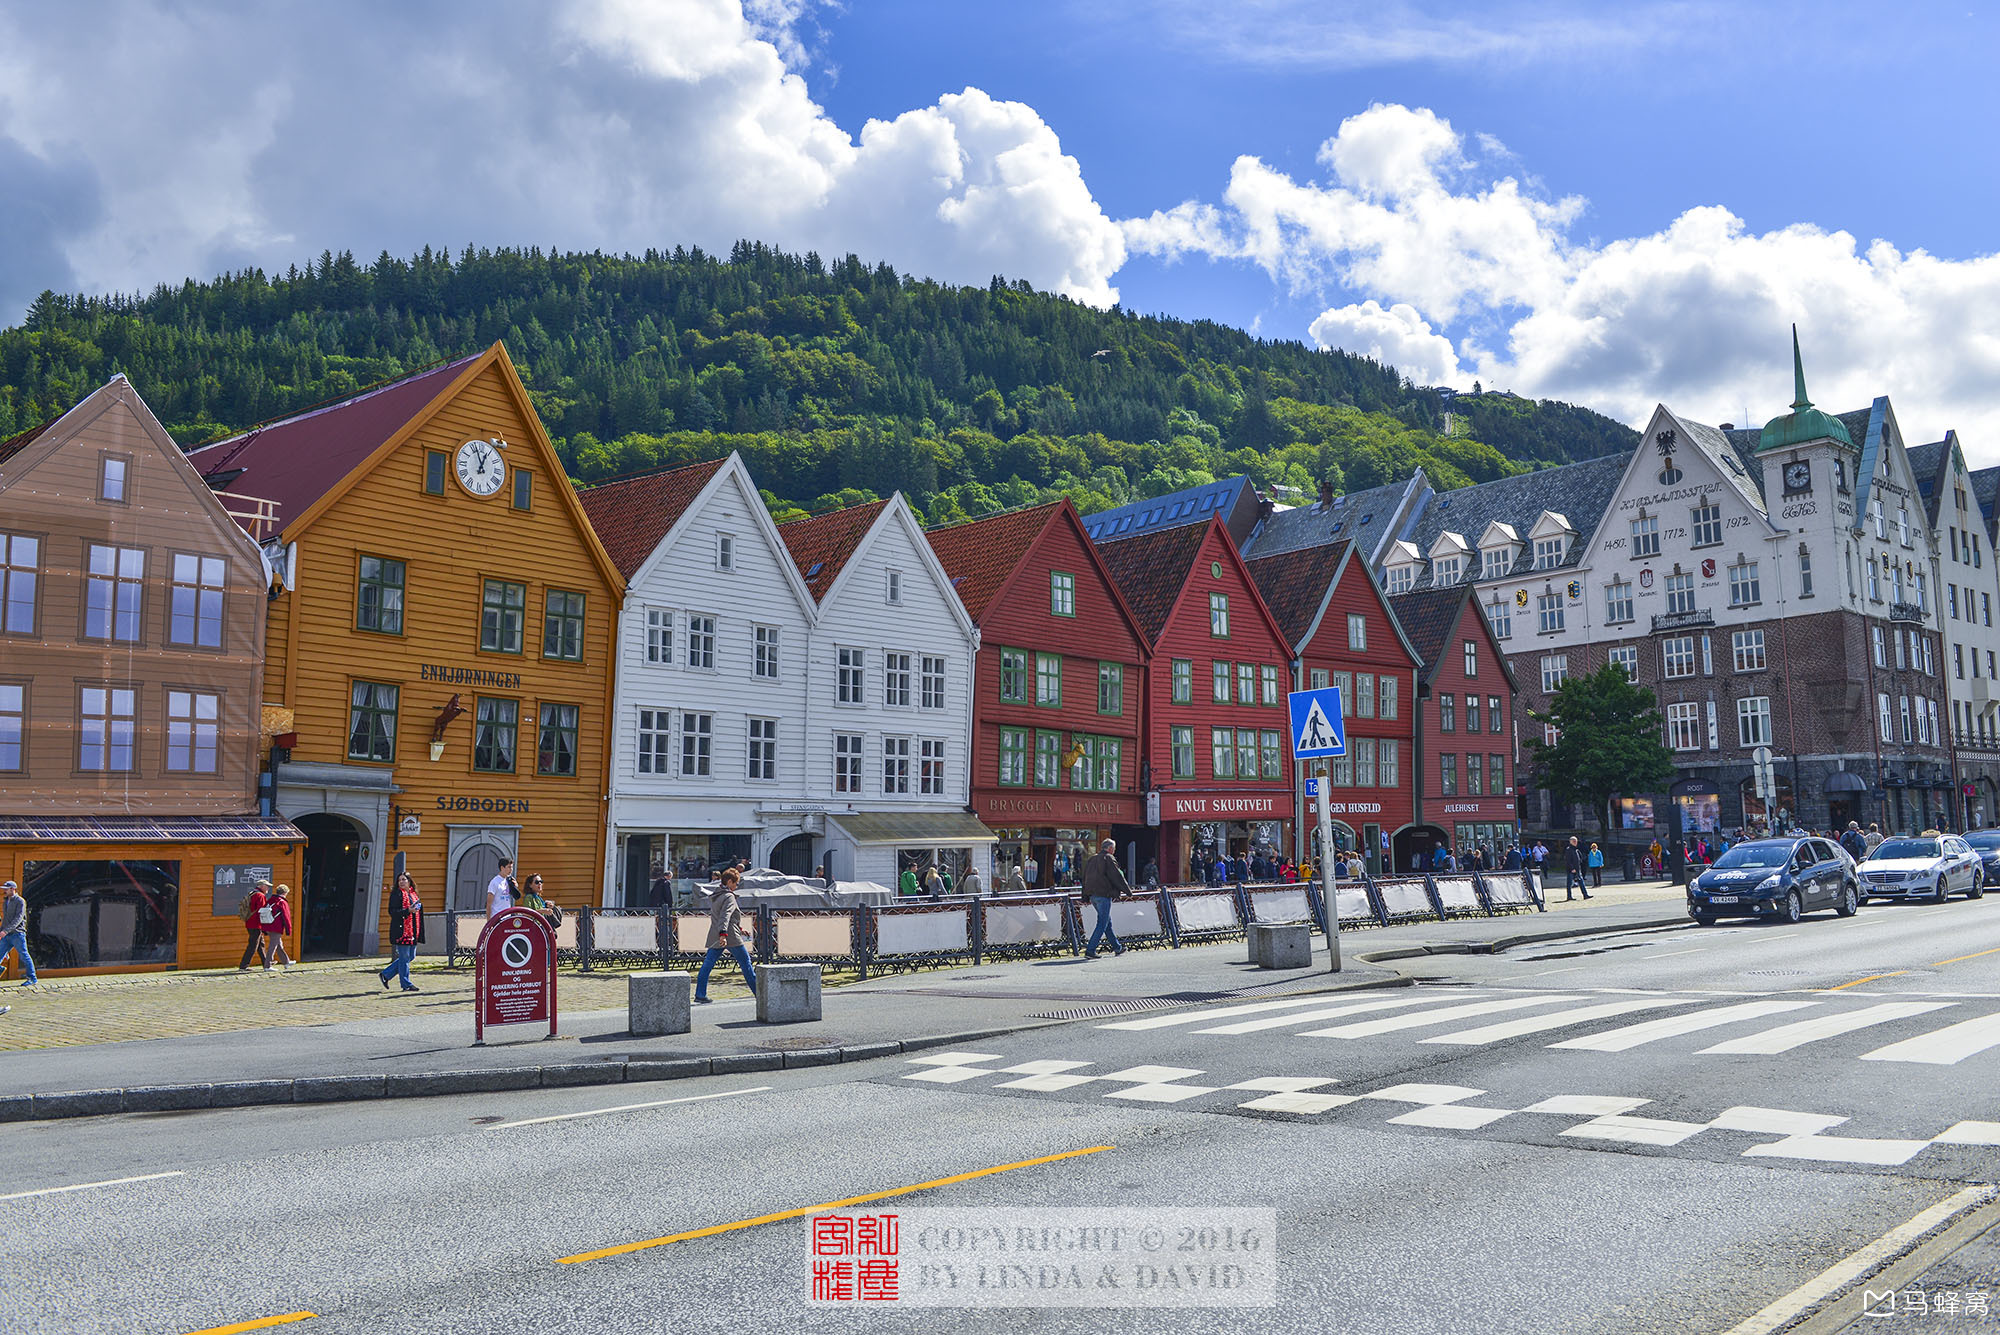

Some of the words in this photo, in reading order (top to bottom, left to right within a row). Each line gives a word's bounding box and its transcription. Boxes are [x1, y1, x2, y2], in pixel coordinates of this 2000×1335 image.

[1663, 528, 1687, 541] 1712.
[1726, 515, 1751, 529] 1912.
[421, 663, 521, 689] ENHJØRNINGEN
[436, 796, 529, 813] SJØBODEN
[989, 799, 1053, 811] BRYGGEN
[1074, 802, 1122, 815] HANDEL
[1176, 800, 1207, 813] KNUT
[1212, 799, 1273, 812] SKURTVEIT
[1309, 803, 1346, 813] BGEN
[1348, 803, 1382, 813] HUSFLID
[1444, 804, 1480, 813] JULEHUSET
